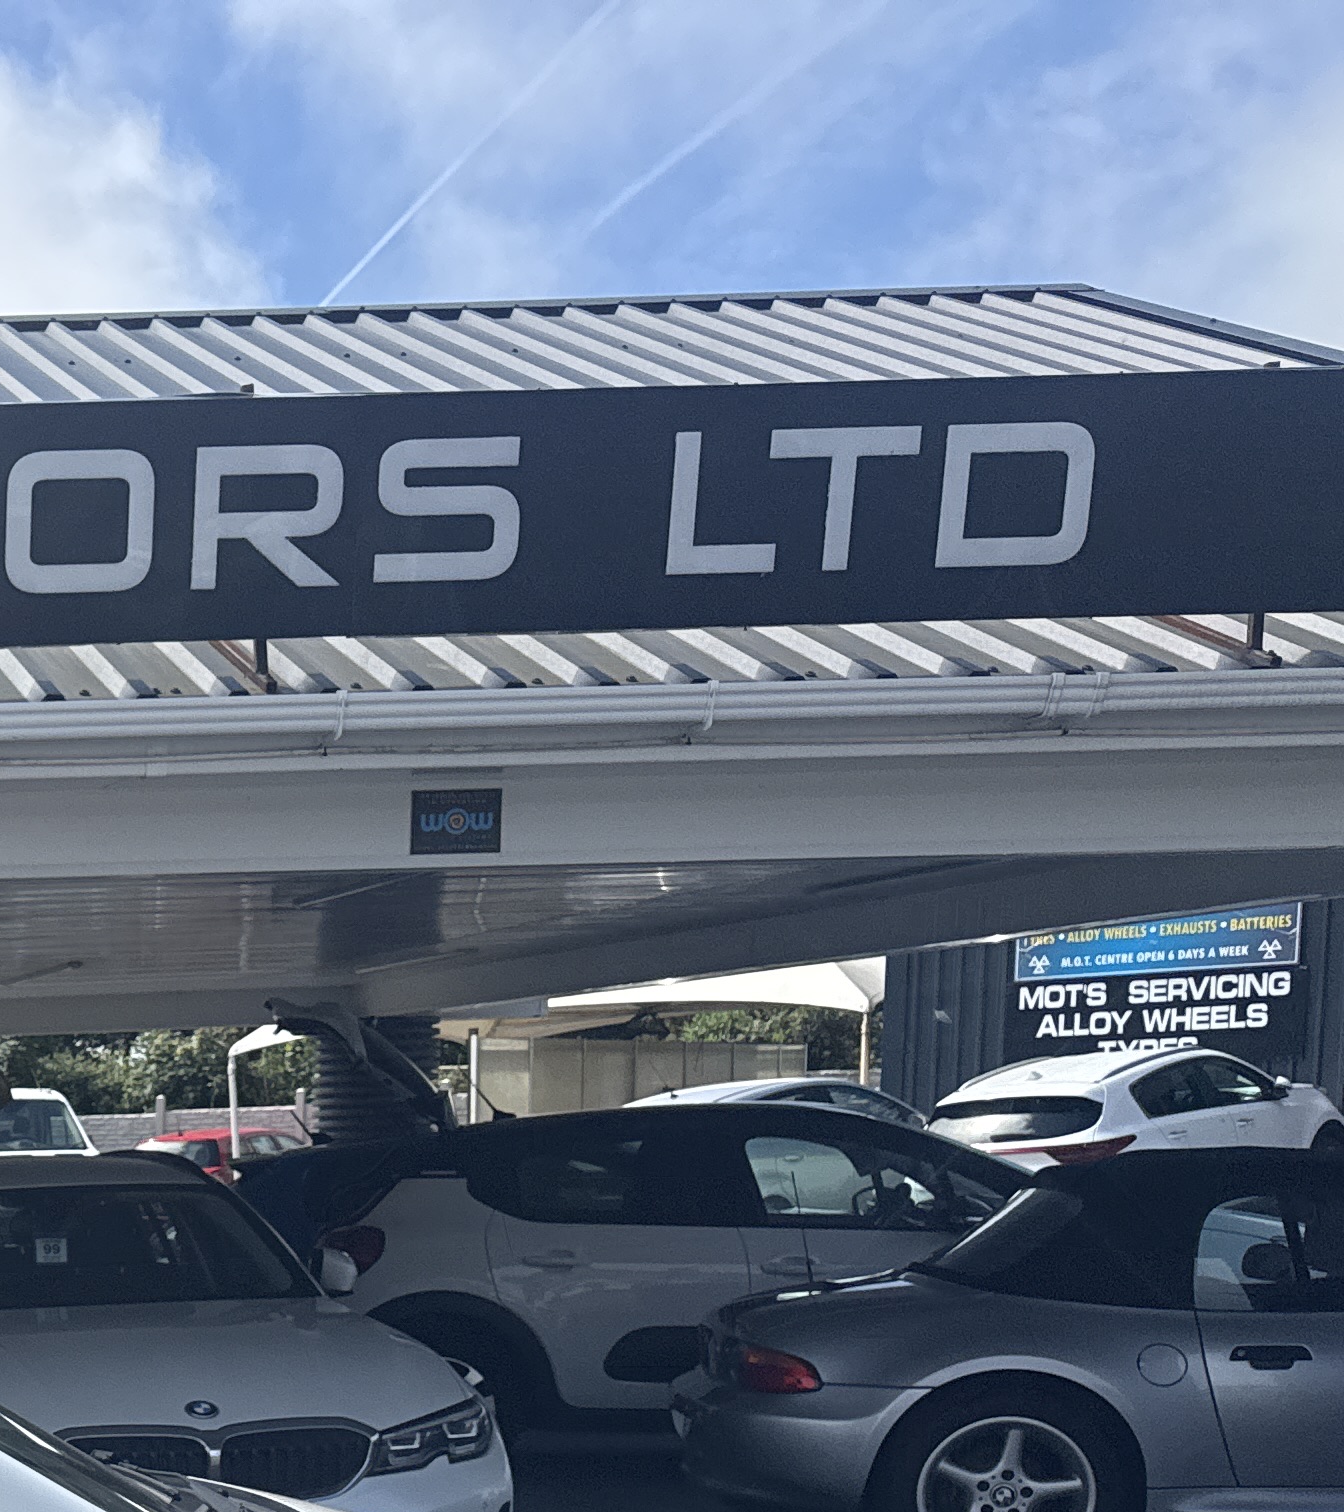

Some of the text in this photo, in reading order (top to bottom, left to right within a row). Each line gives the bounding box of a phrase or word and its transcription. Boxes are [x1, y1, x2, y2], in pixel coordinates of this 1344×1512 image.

[665, 421, 1096, 576] LTD
[1066, 927, 1101, 943] ALLOY
[1104, 925, 1147, 940] WHEELS
[1159, 919, 1217, 936] EXHAUSTS
[1229, 914, 1292, 931] BATTERIES
[1095, 952, 1134, 966] CENTRE
[1136, 949, 1166, 963] OPEN
[1168, 949, 1175, 961] 6
[1178, 947, 1205, 960] DAYS
[1207, 946, 1216, 958] A
[1219, 944, 1249, 957] WEEK
[1018, 971, 1291, 1011] MOT'S SERVICING
[1035, 1002, 1268, 1039] ALLOY WHEELS
